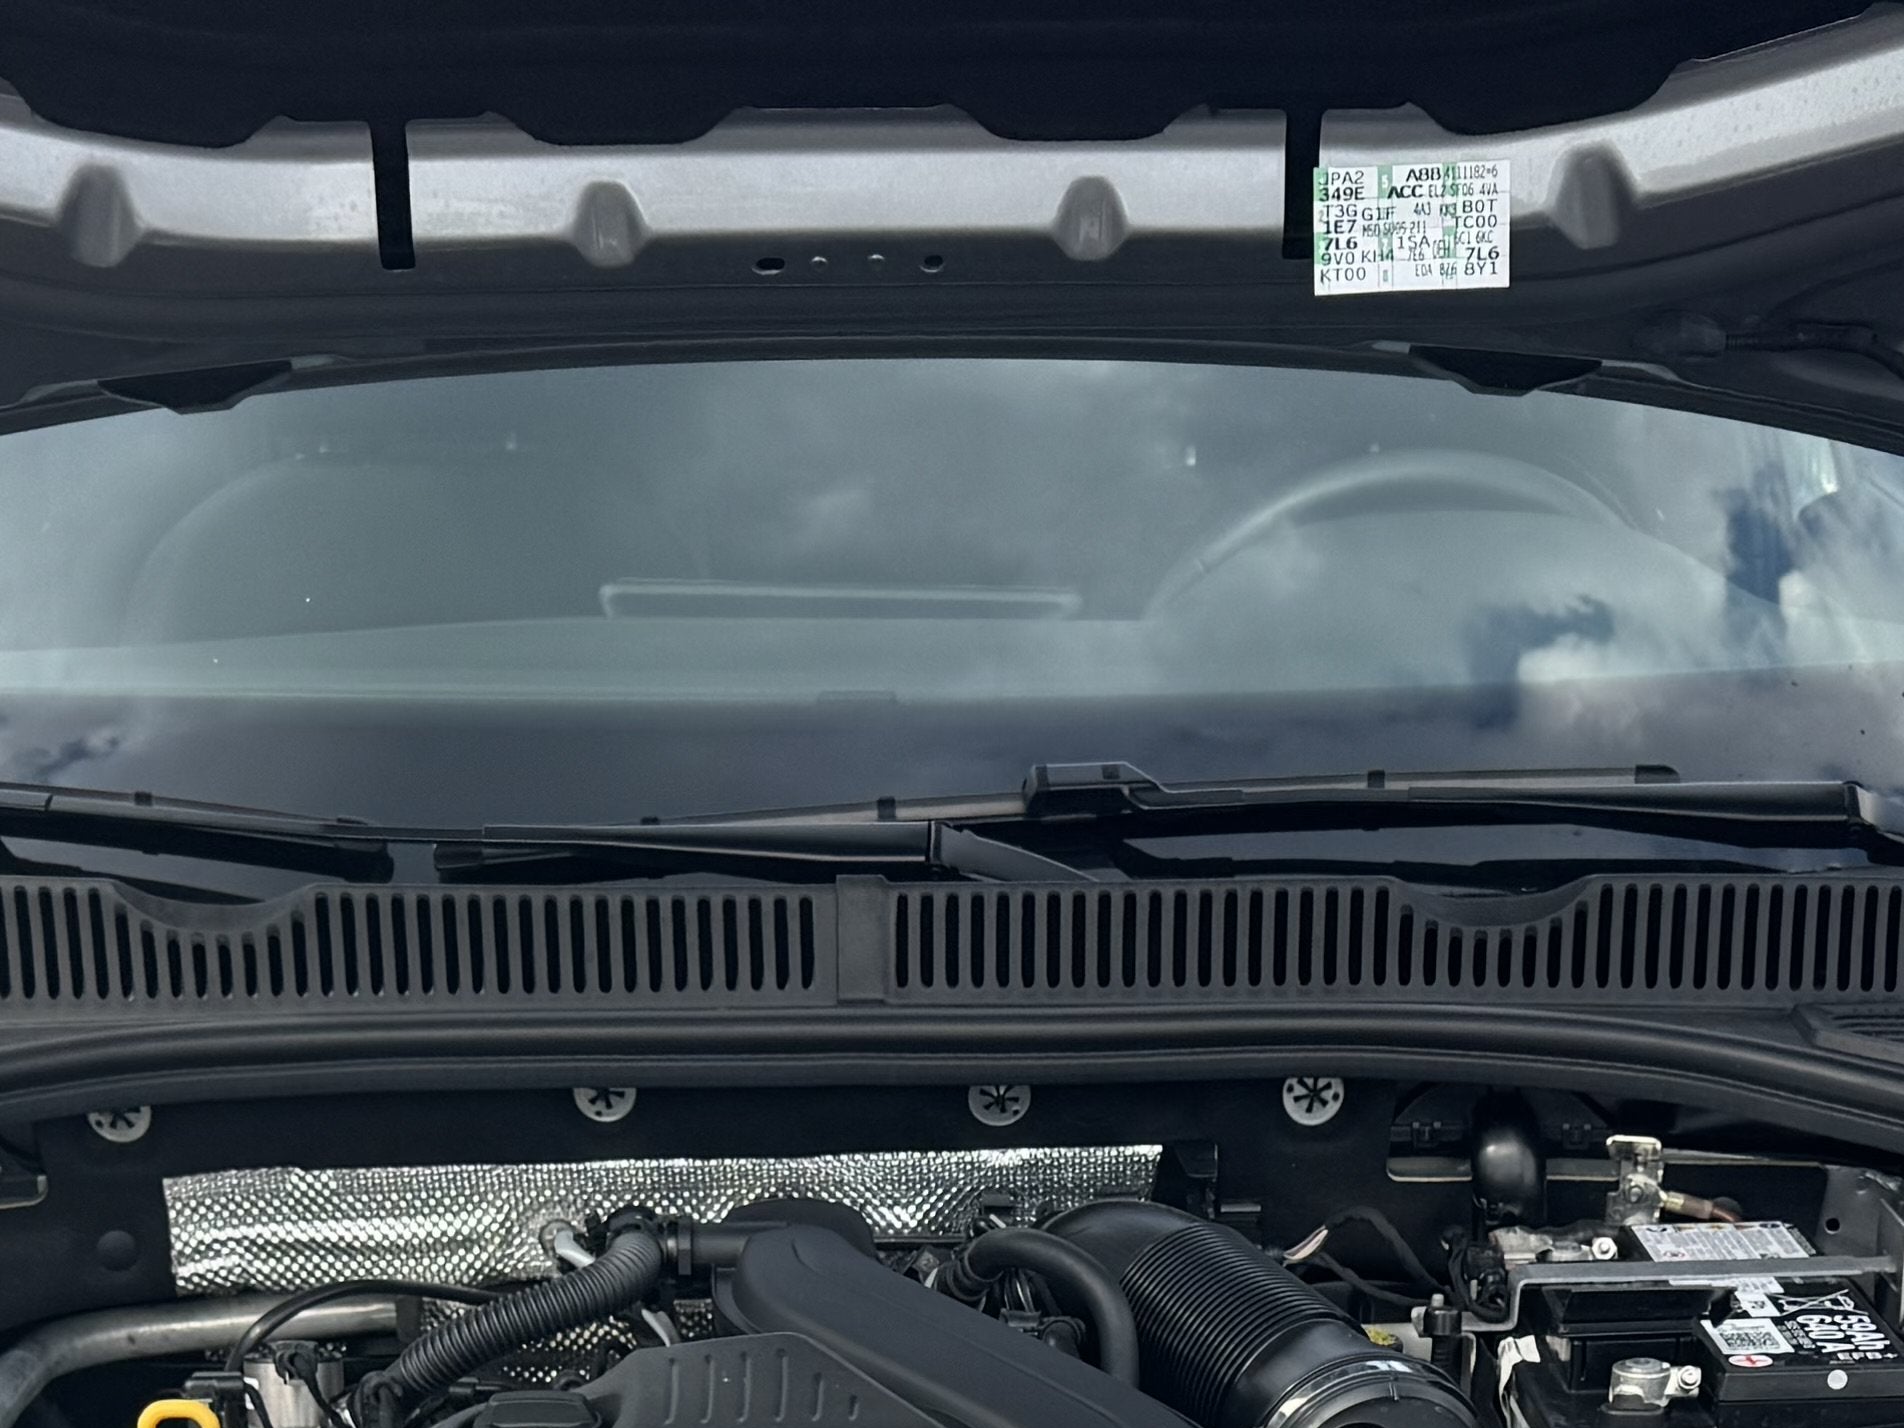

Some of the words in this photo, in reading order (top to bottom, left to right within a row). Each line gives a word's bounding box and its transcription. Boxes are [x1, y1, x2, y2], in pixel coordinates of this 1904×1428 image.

[1322, 236, 1358, 251] 7L6
[1465, 245, 1500, 262] 7L6
[1464, 261, 1498, 276] 8Y1
